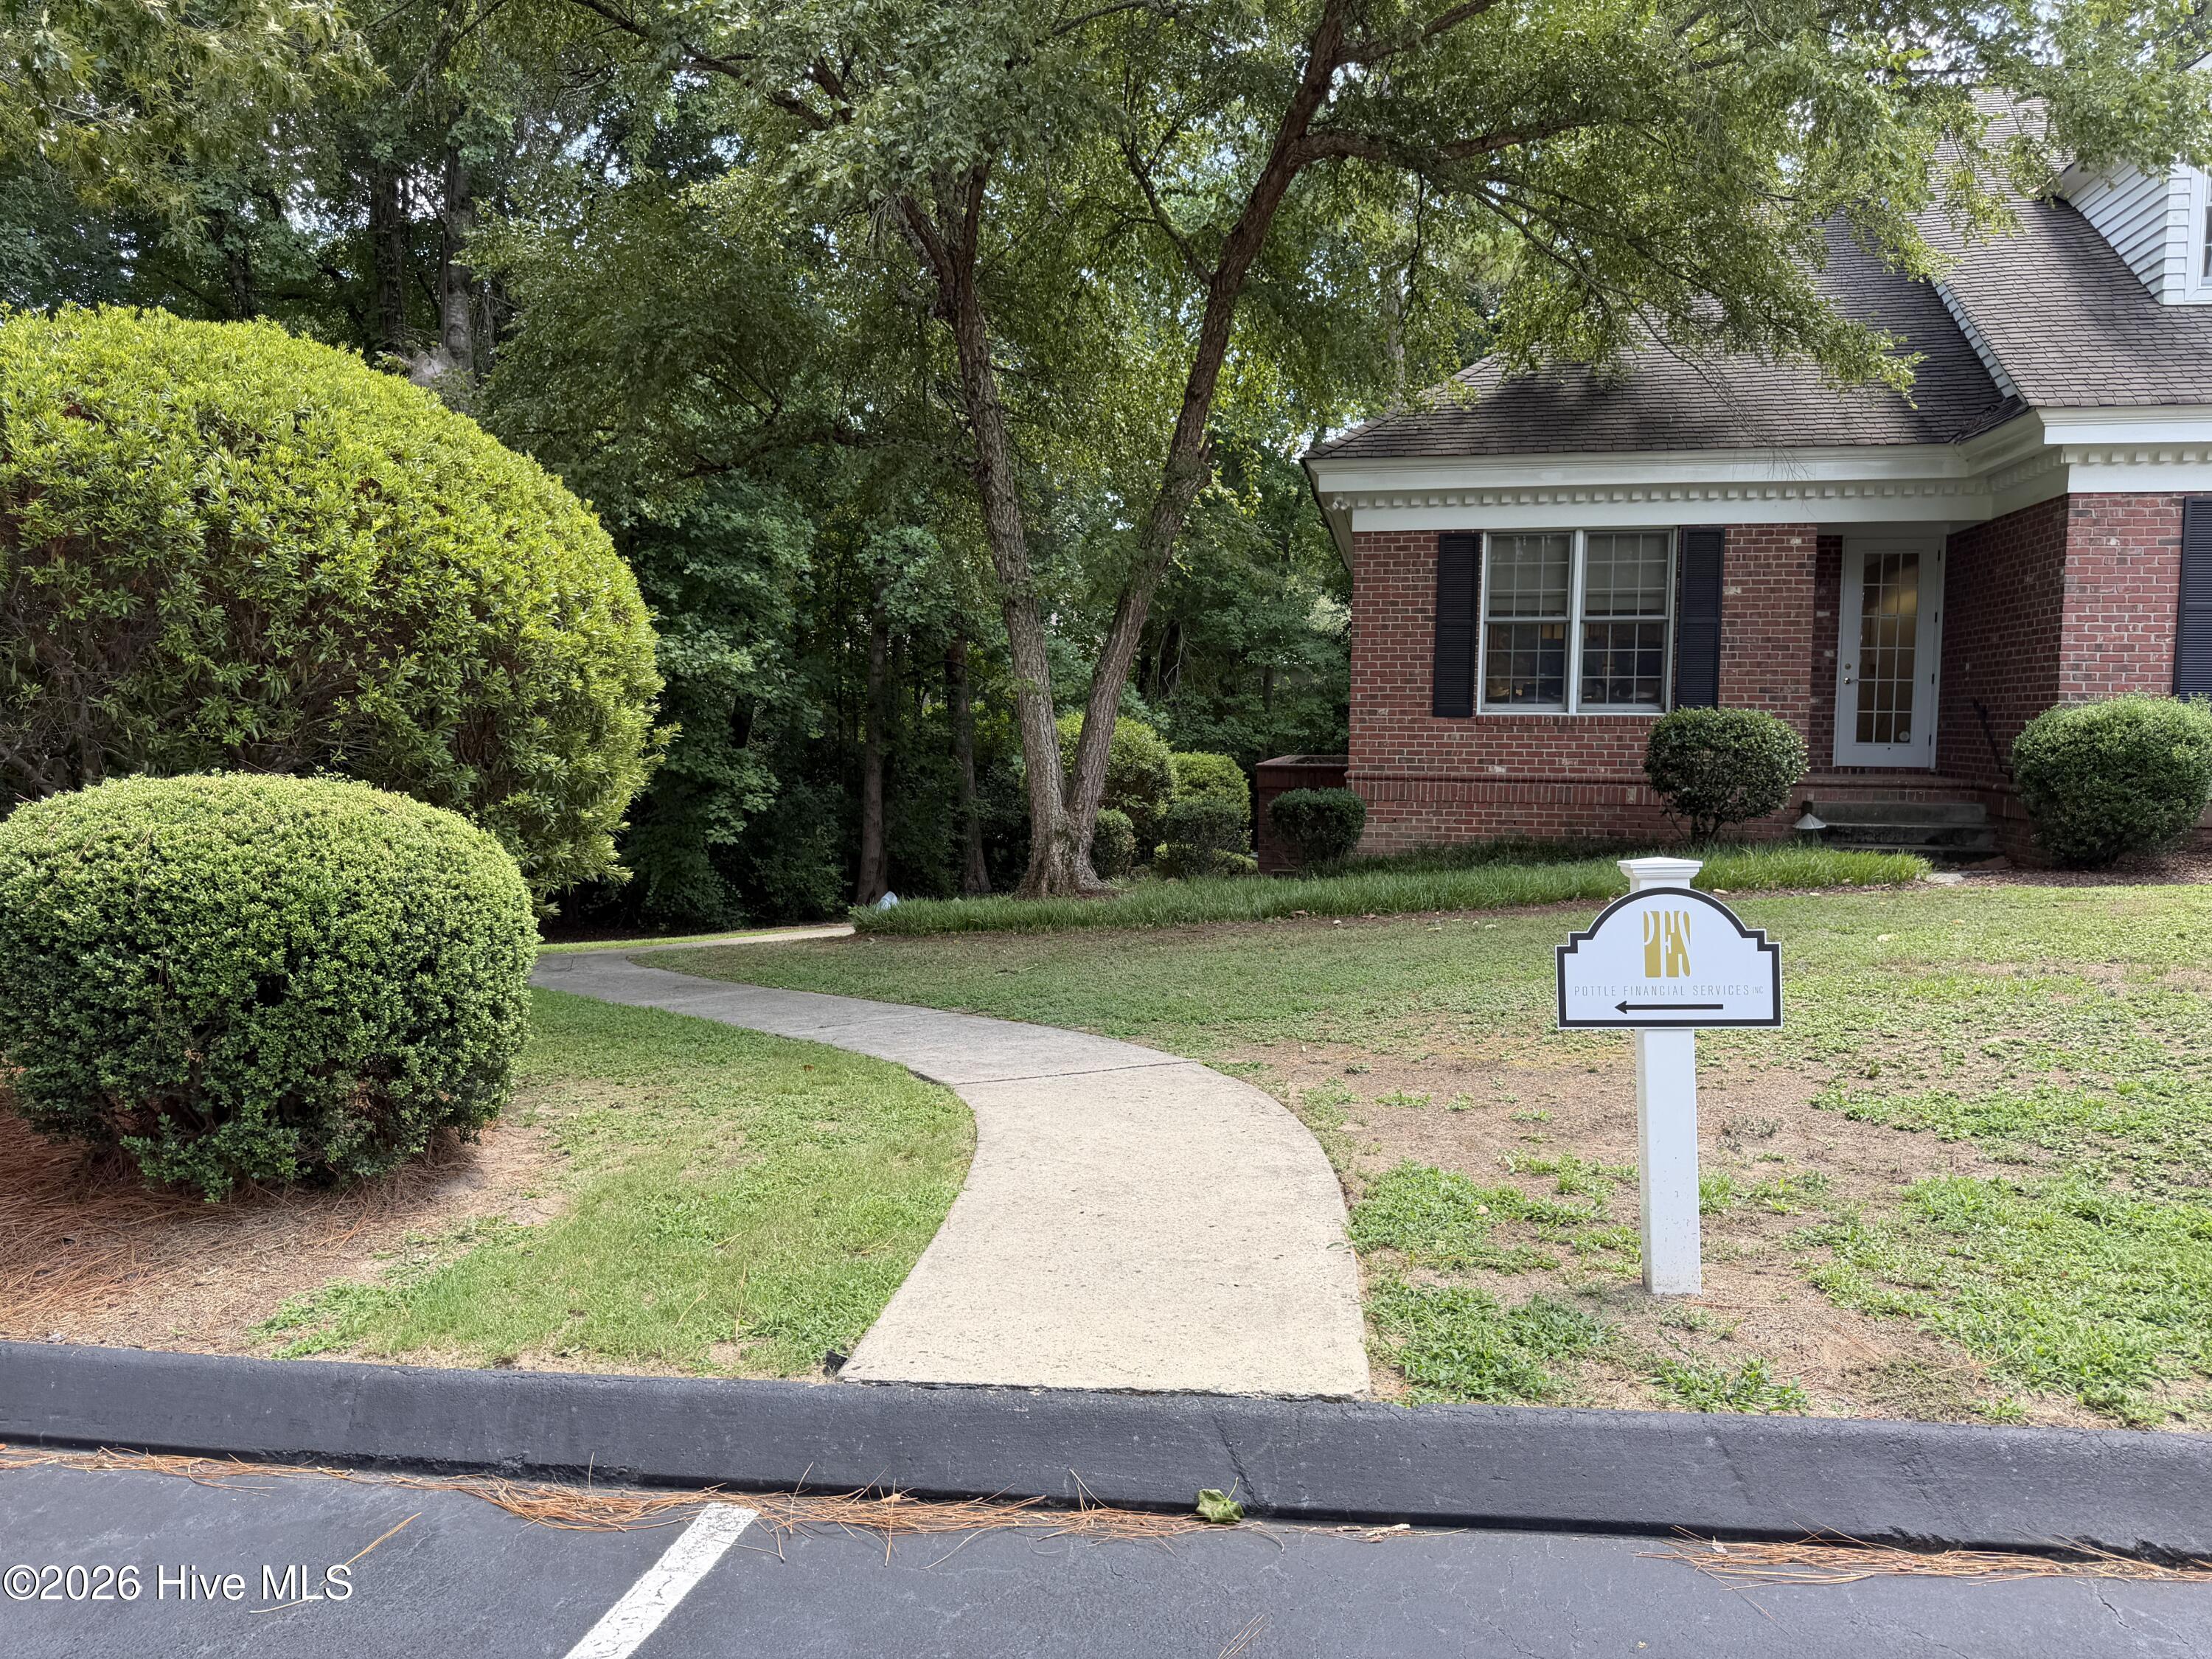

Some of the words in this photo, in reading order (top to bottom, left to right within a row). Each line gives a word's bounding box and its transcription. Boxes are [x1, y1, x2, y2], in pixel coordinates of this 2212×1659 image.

[1574, 986, 1617, 997] POTTLE
[1624, 985, 1686, 996] FINANCIAL
[1692, 984, 1749, 995] SERVICES
